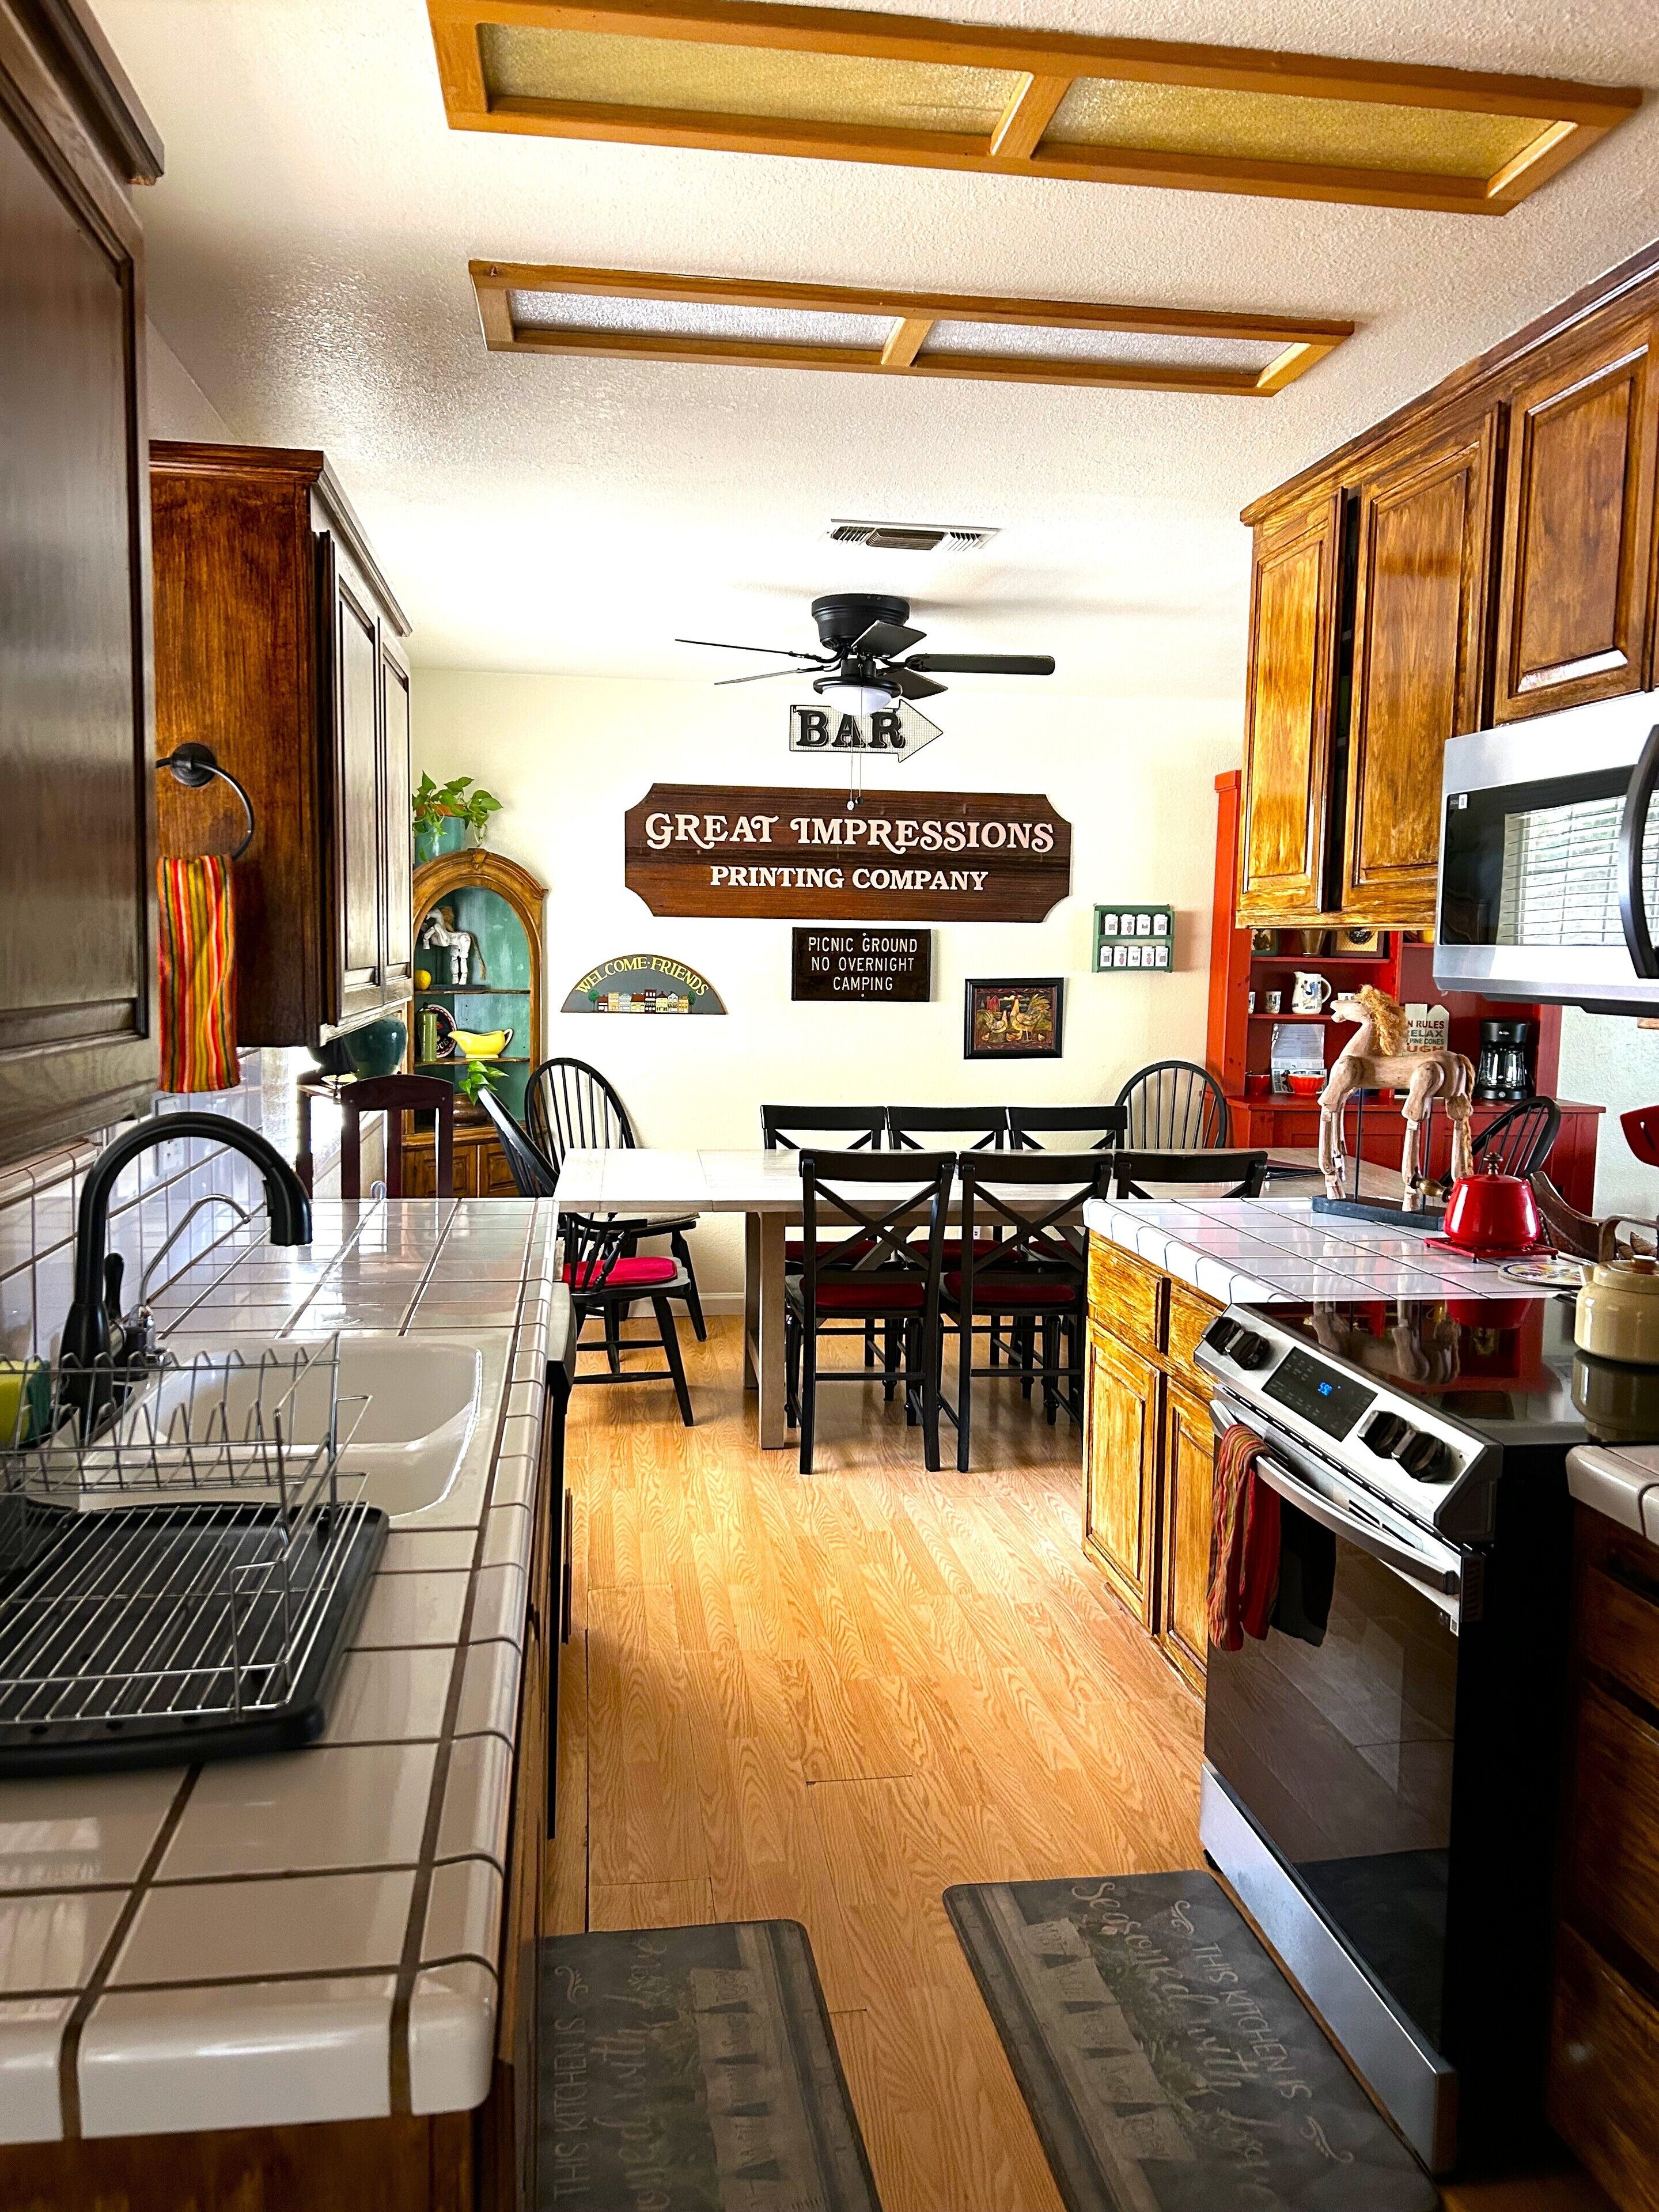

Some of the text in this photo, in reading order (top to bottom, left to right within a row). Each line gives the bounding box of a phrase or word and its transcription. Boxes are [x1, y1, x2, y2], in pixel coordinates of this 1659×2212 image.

[796, 710, 906, 749] BAR
[645, 812, 1054, 855] GREAT IMPRESSIONS
[710, 866, 988, 891] PRINTING COMPANY
[808, 937, 918, 952] PICNIC GROUND
[575, 956, 709, 996] WELCOME FRIENDS
[811, 956, 915, 971] NO OVERNIGHT
[833, 976, 893, 991] CAMPING
[1408, 1029, 1444, 1037] ELAX
[1416, 1020, 1445, 1029] RULES
[1192, 1941, 1313, 2100] THIS KITCHEN IS
[554, 2017, 590, 2201] THIS KITCHEN IS
